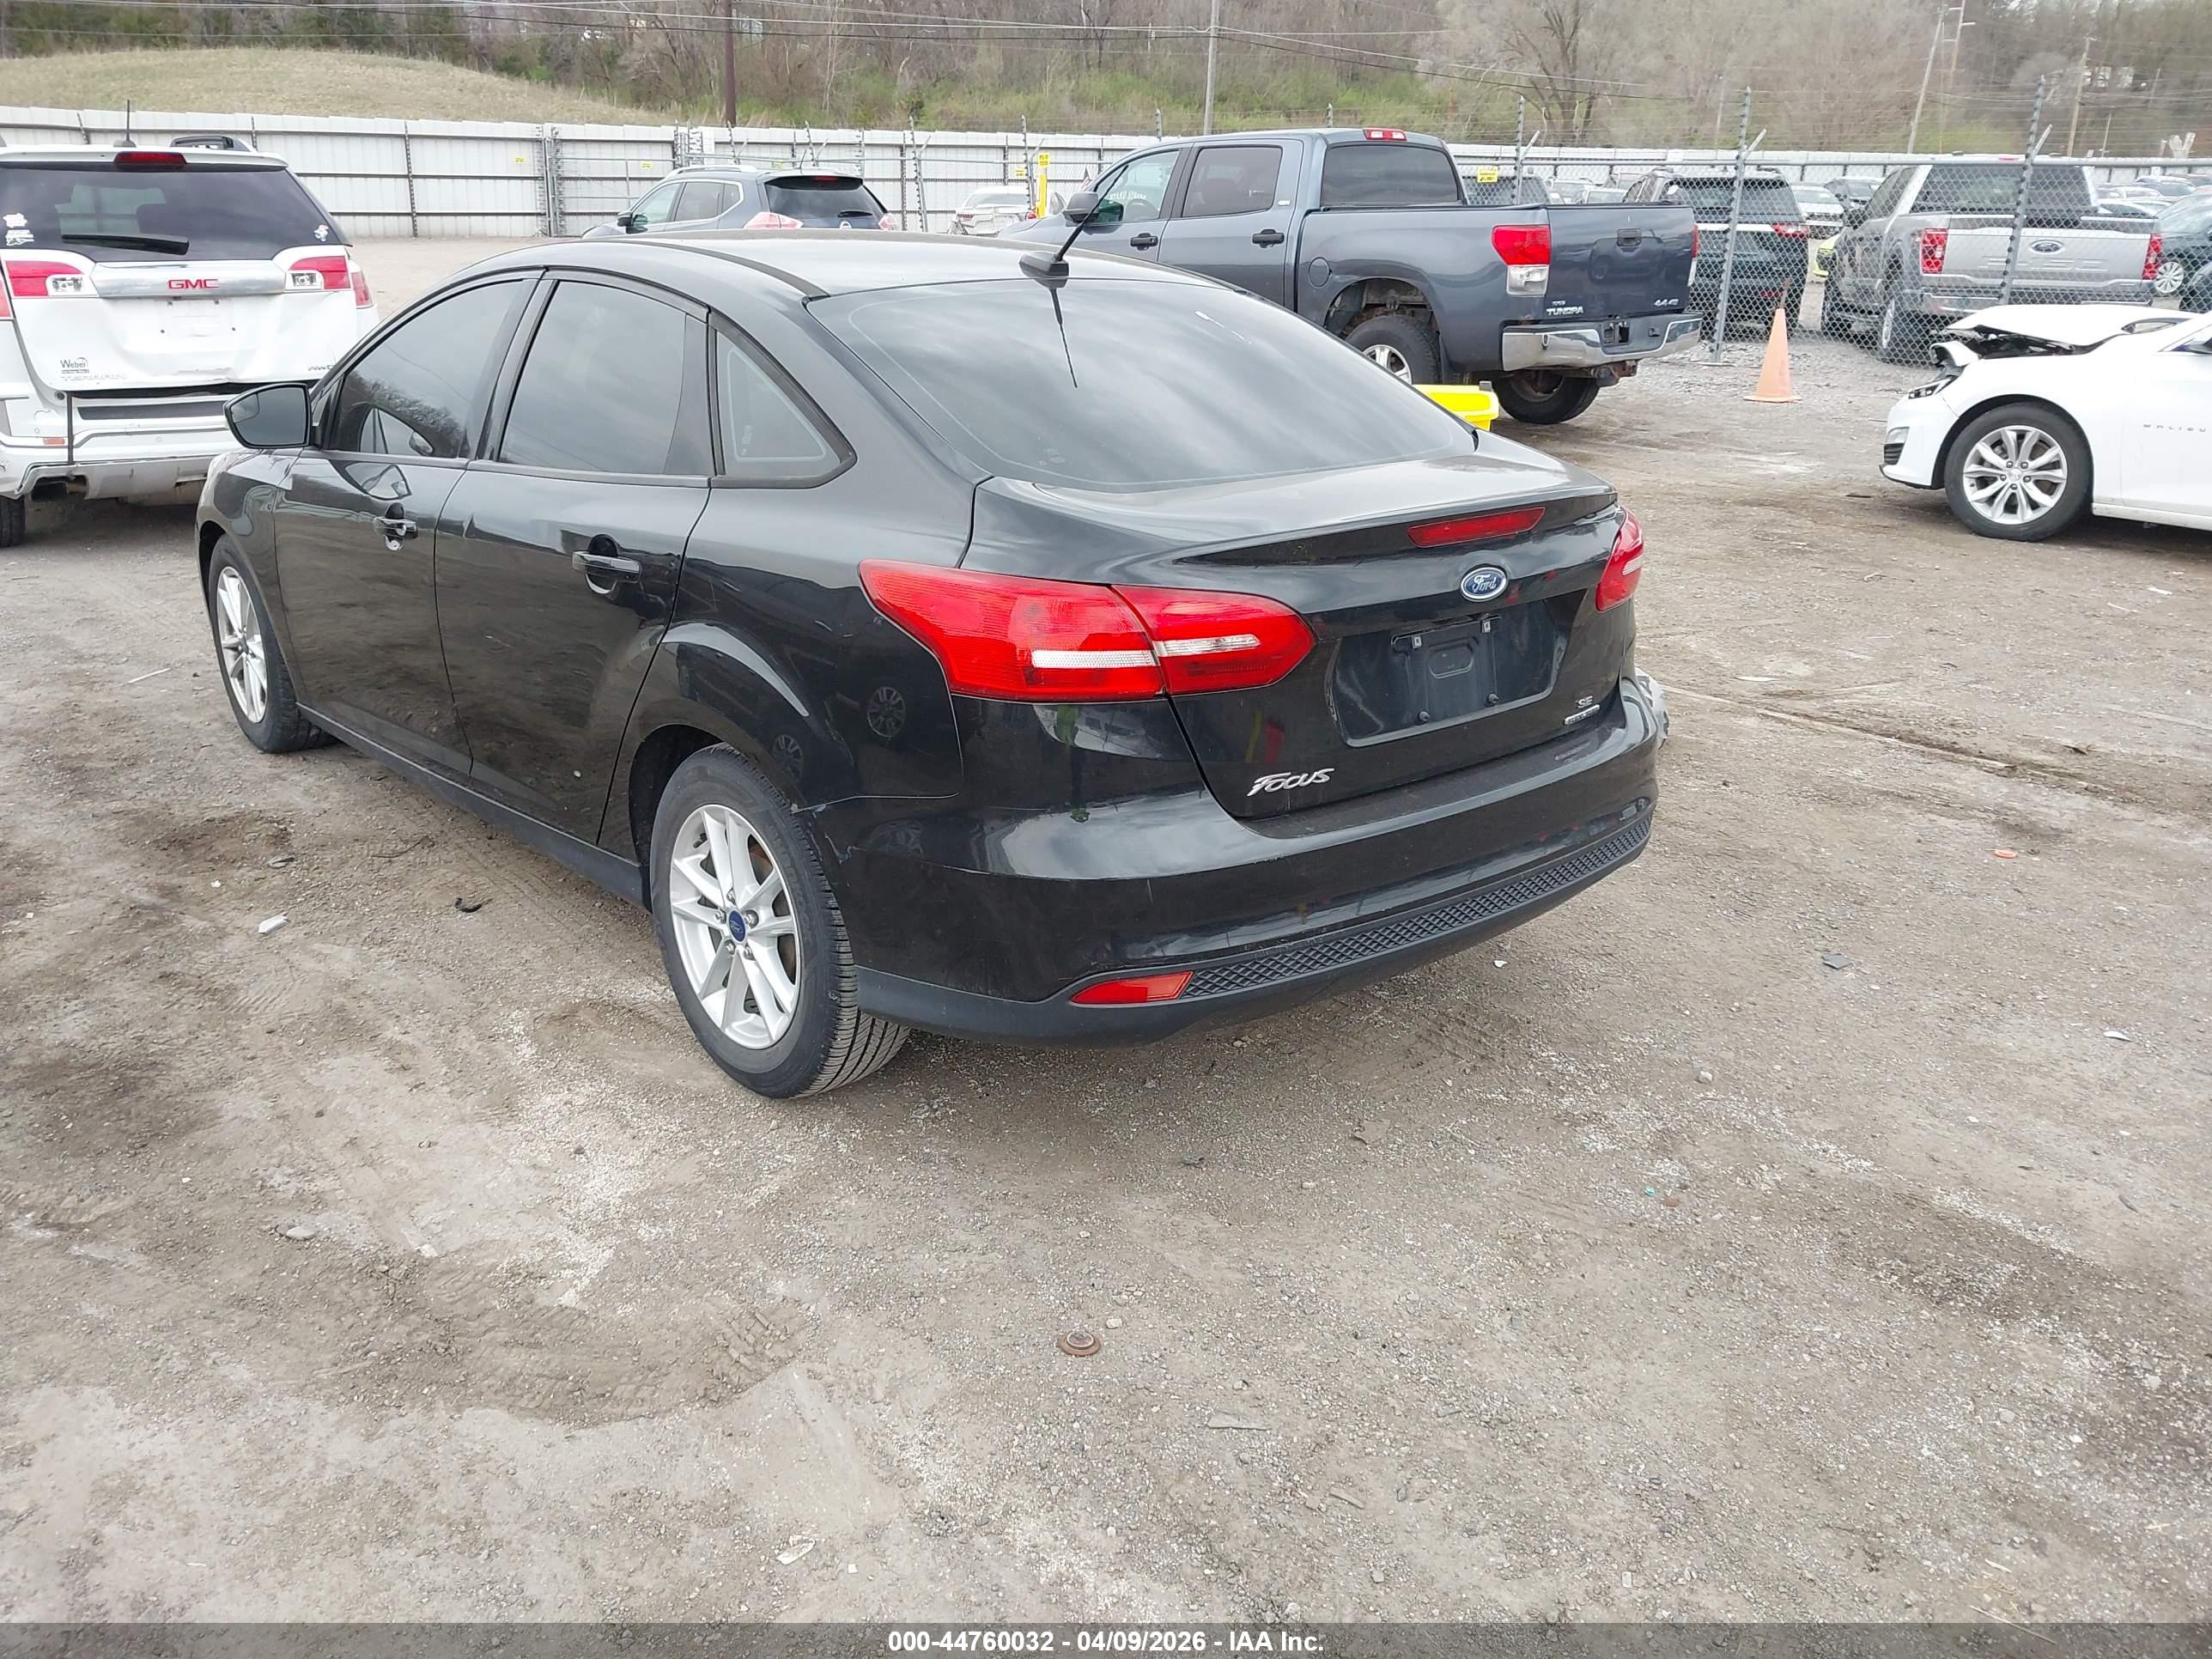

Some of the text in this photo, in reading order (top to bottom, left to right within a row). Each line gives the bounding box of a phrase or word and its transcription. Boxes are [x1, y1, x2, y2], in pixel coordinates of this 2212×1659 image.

[167, 278, 220, 290] GMC
[1546, 306, 1584, 316] TUNDRA
[60, 358, 87, 368] Weber
